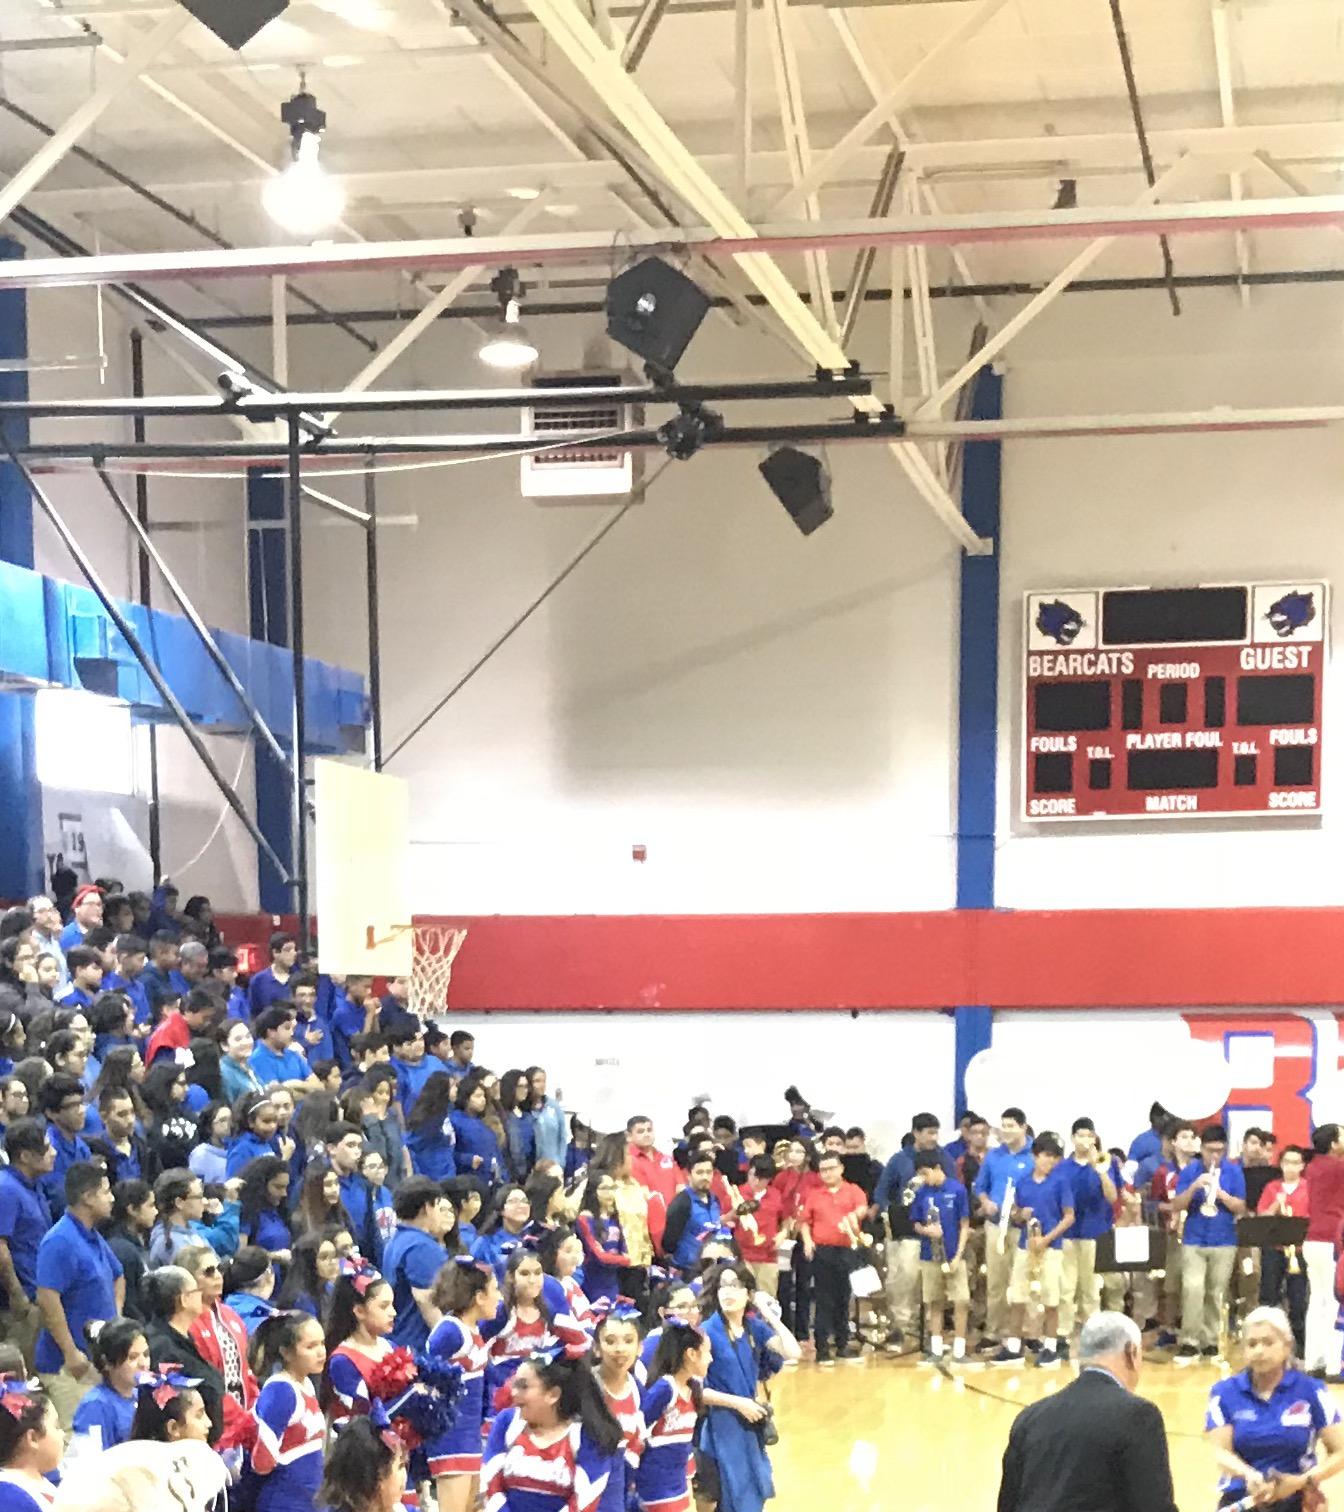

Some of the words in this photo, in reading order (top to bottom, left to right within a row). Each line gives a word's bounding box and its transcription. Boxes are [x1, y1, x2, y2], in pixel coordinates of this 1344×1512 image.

[1029, 651, 1134, 677] BEARCATS
[1240, 646, 1313, 670] GUEST
[1147, 663, 1200, 679] PERIOD
[1030, 736, 1077, 752] FOULS
[1126, 733, 1182, 750] PLAYER
[1186, 731, 1223, 748] FOUL
[1269, 728, 1318, 745] FOULS
[1030, 798, 1076, 815] SCORE
[1145, 795, 1198, 811] MATCH
[1268, 791, 1317, 808] SCORE
